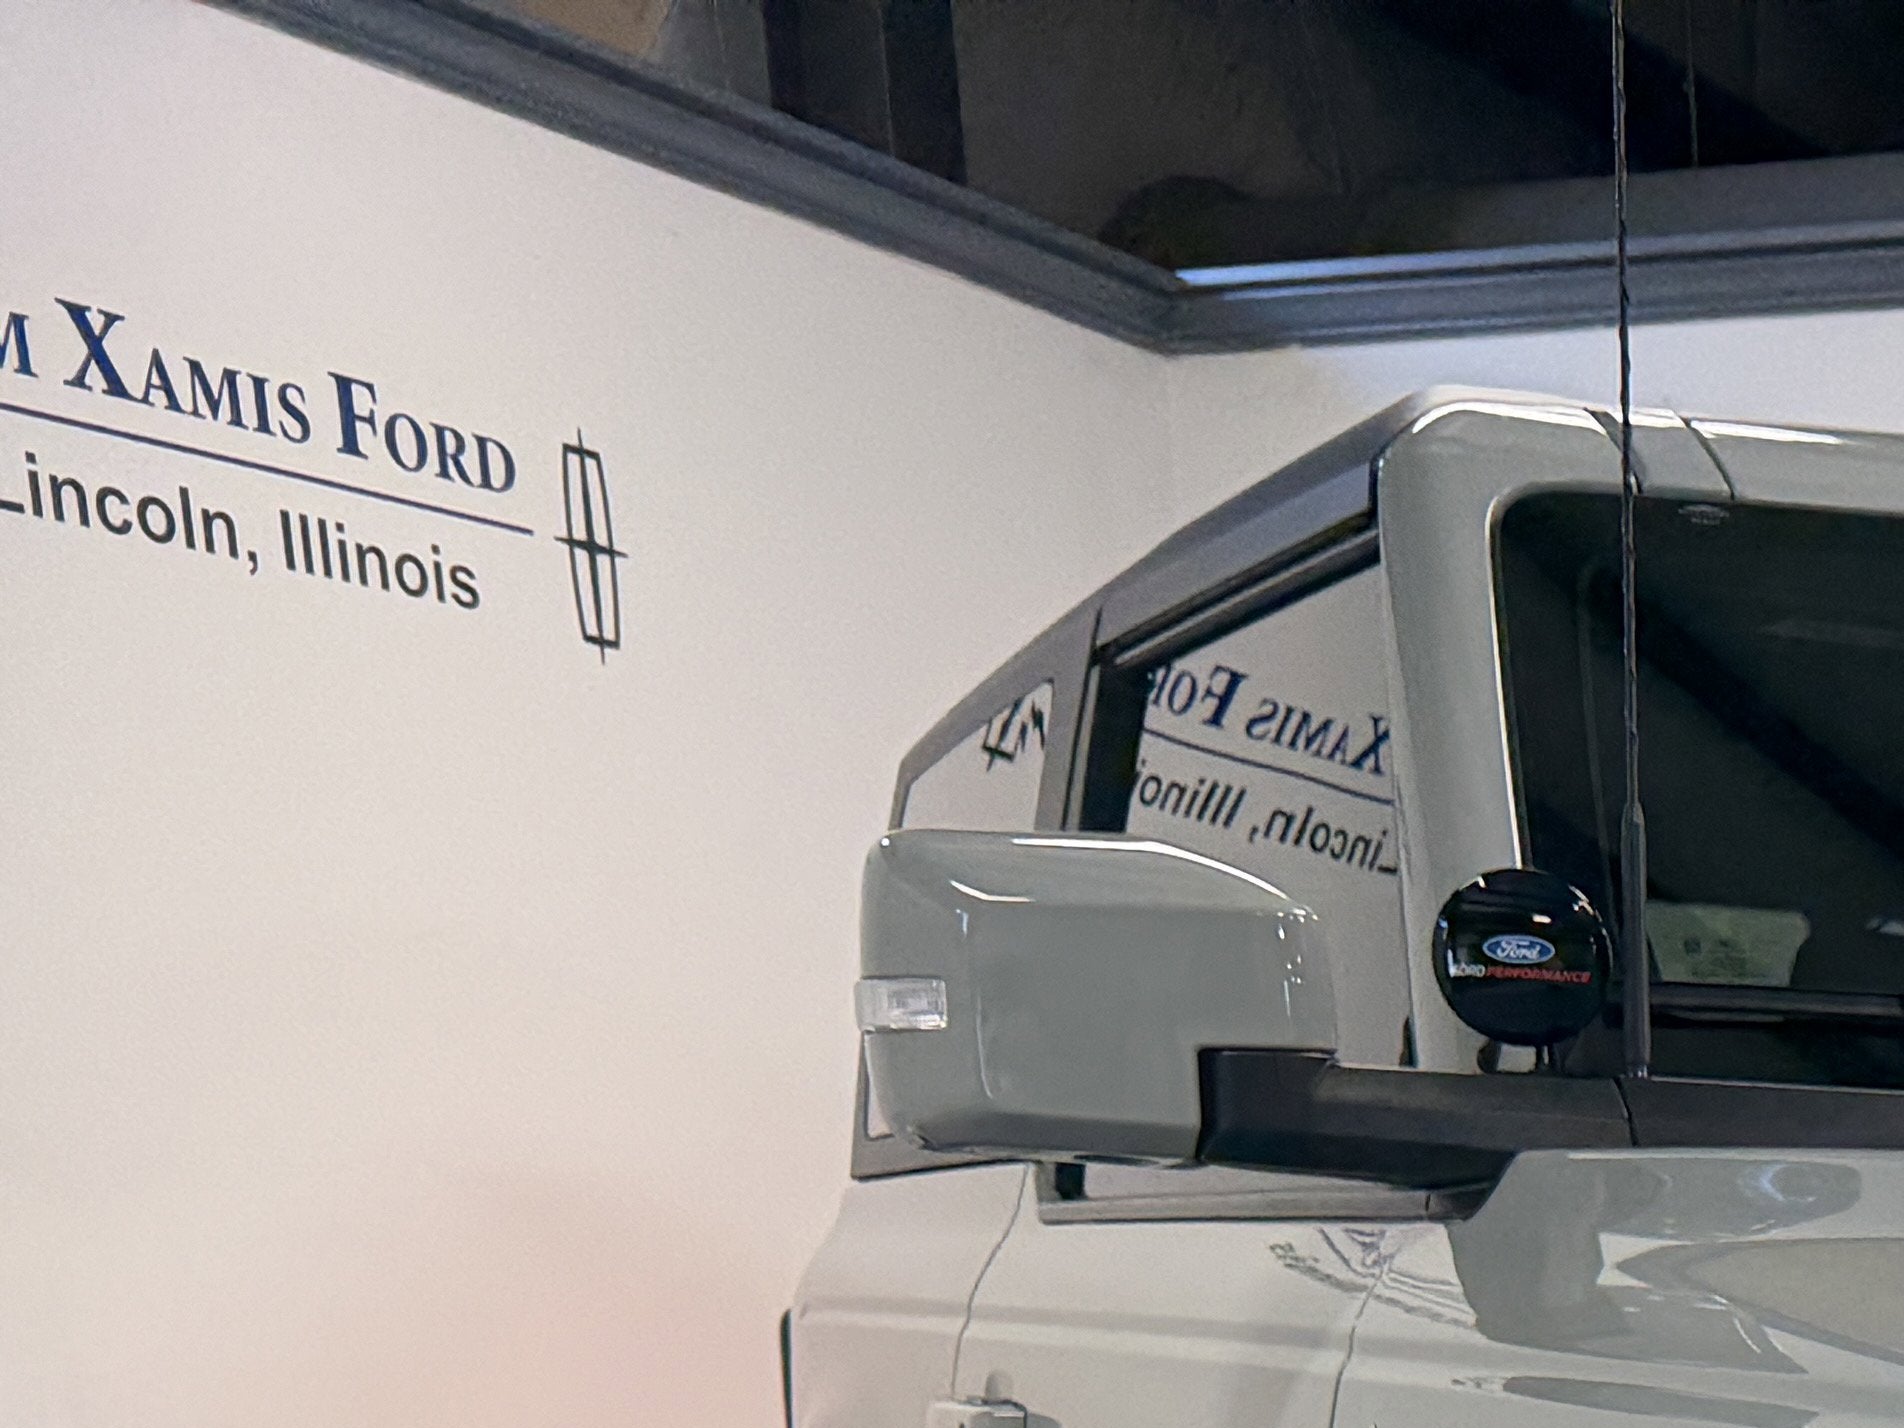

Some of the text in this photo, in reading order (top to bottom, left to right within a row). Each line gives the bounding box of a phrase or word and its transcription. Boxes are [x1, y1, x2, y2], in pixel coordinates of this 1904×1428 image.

[54, 297, 311, 444] XAMIS
[326, 371, 516, 494] FORD
[279, 509, 481, 610] Illinois
